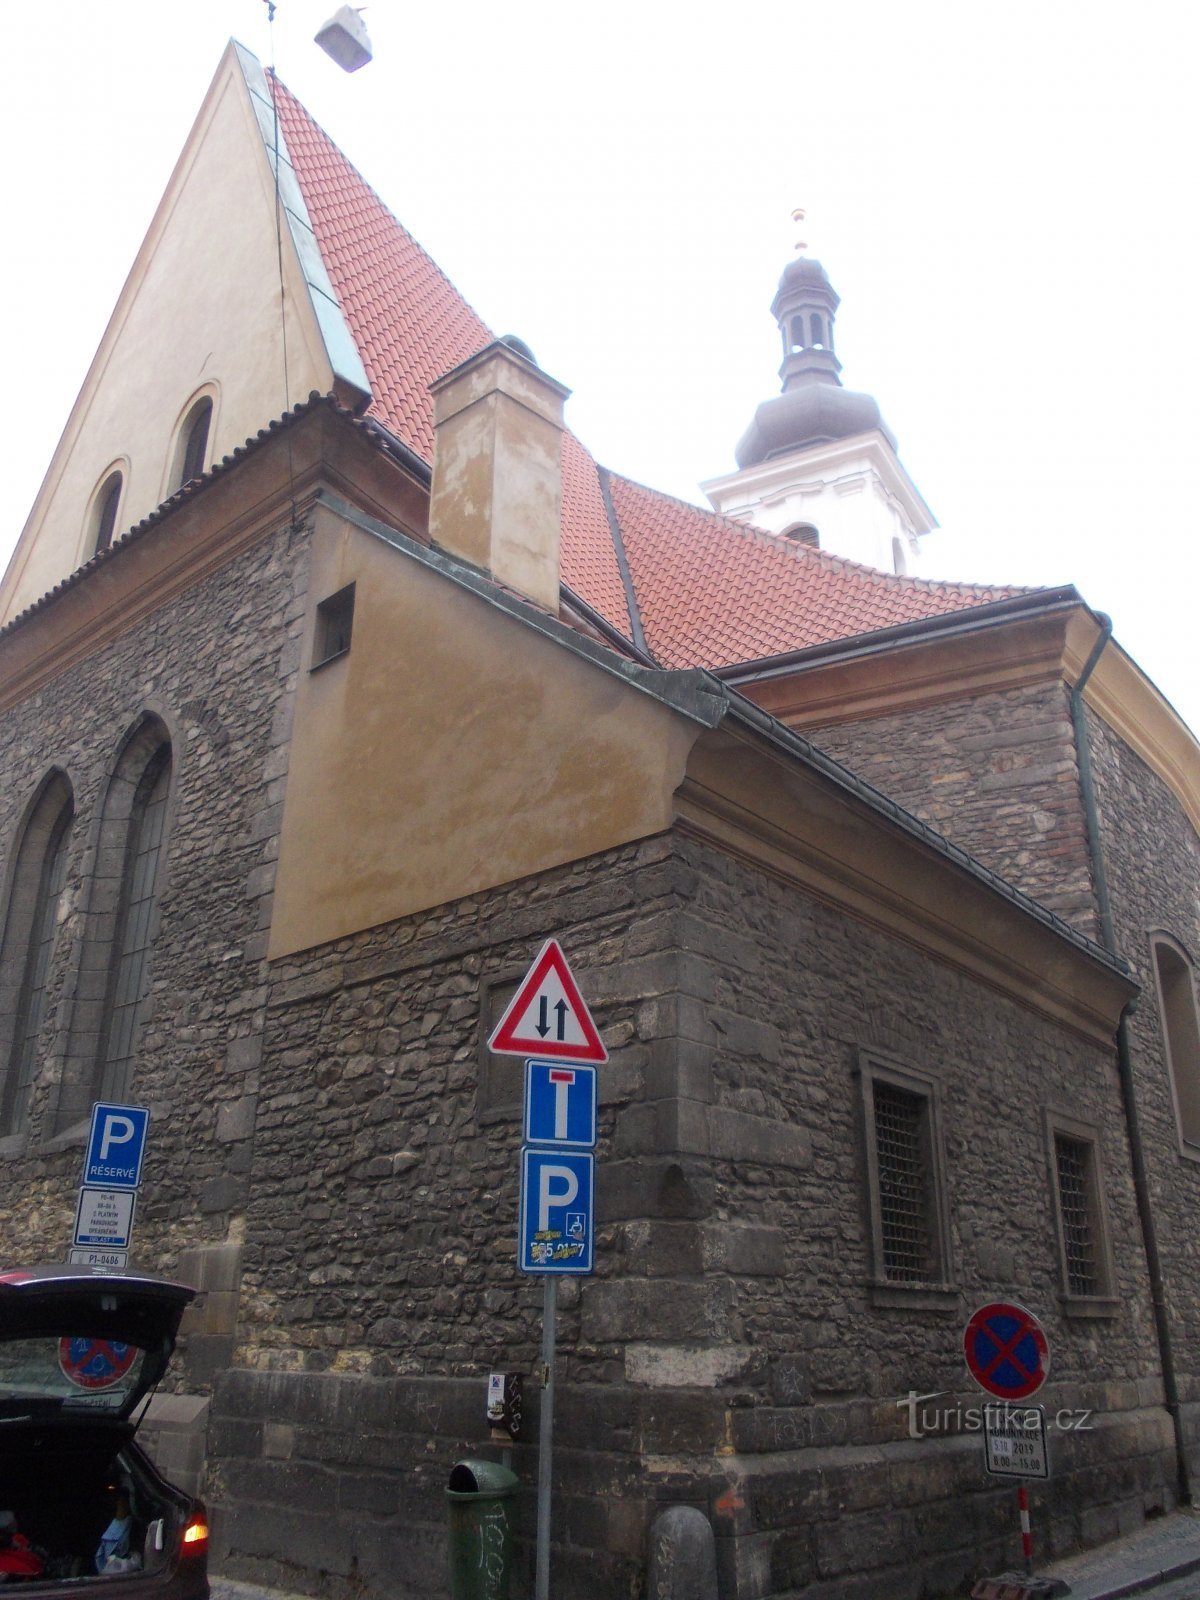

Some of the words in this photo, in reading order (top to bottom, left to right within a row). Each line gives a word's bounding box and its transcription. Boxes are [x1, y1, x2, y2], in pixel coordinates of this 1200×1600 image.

[99, 1114, 135, 1160] P
[90, 1164, 136, 1179] RÉSERVÉ
[538, 1164, 579, 1232] P
[1013, 1441, 1034, 1455] 2019
